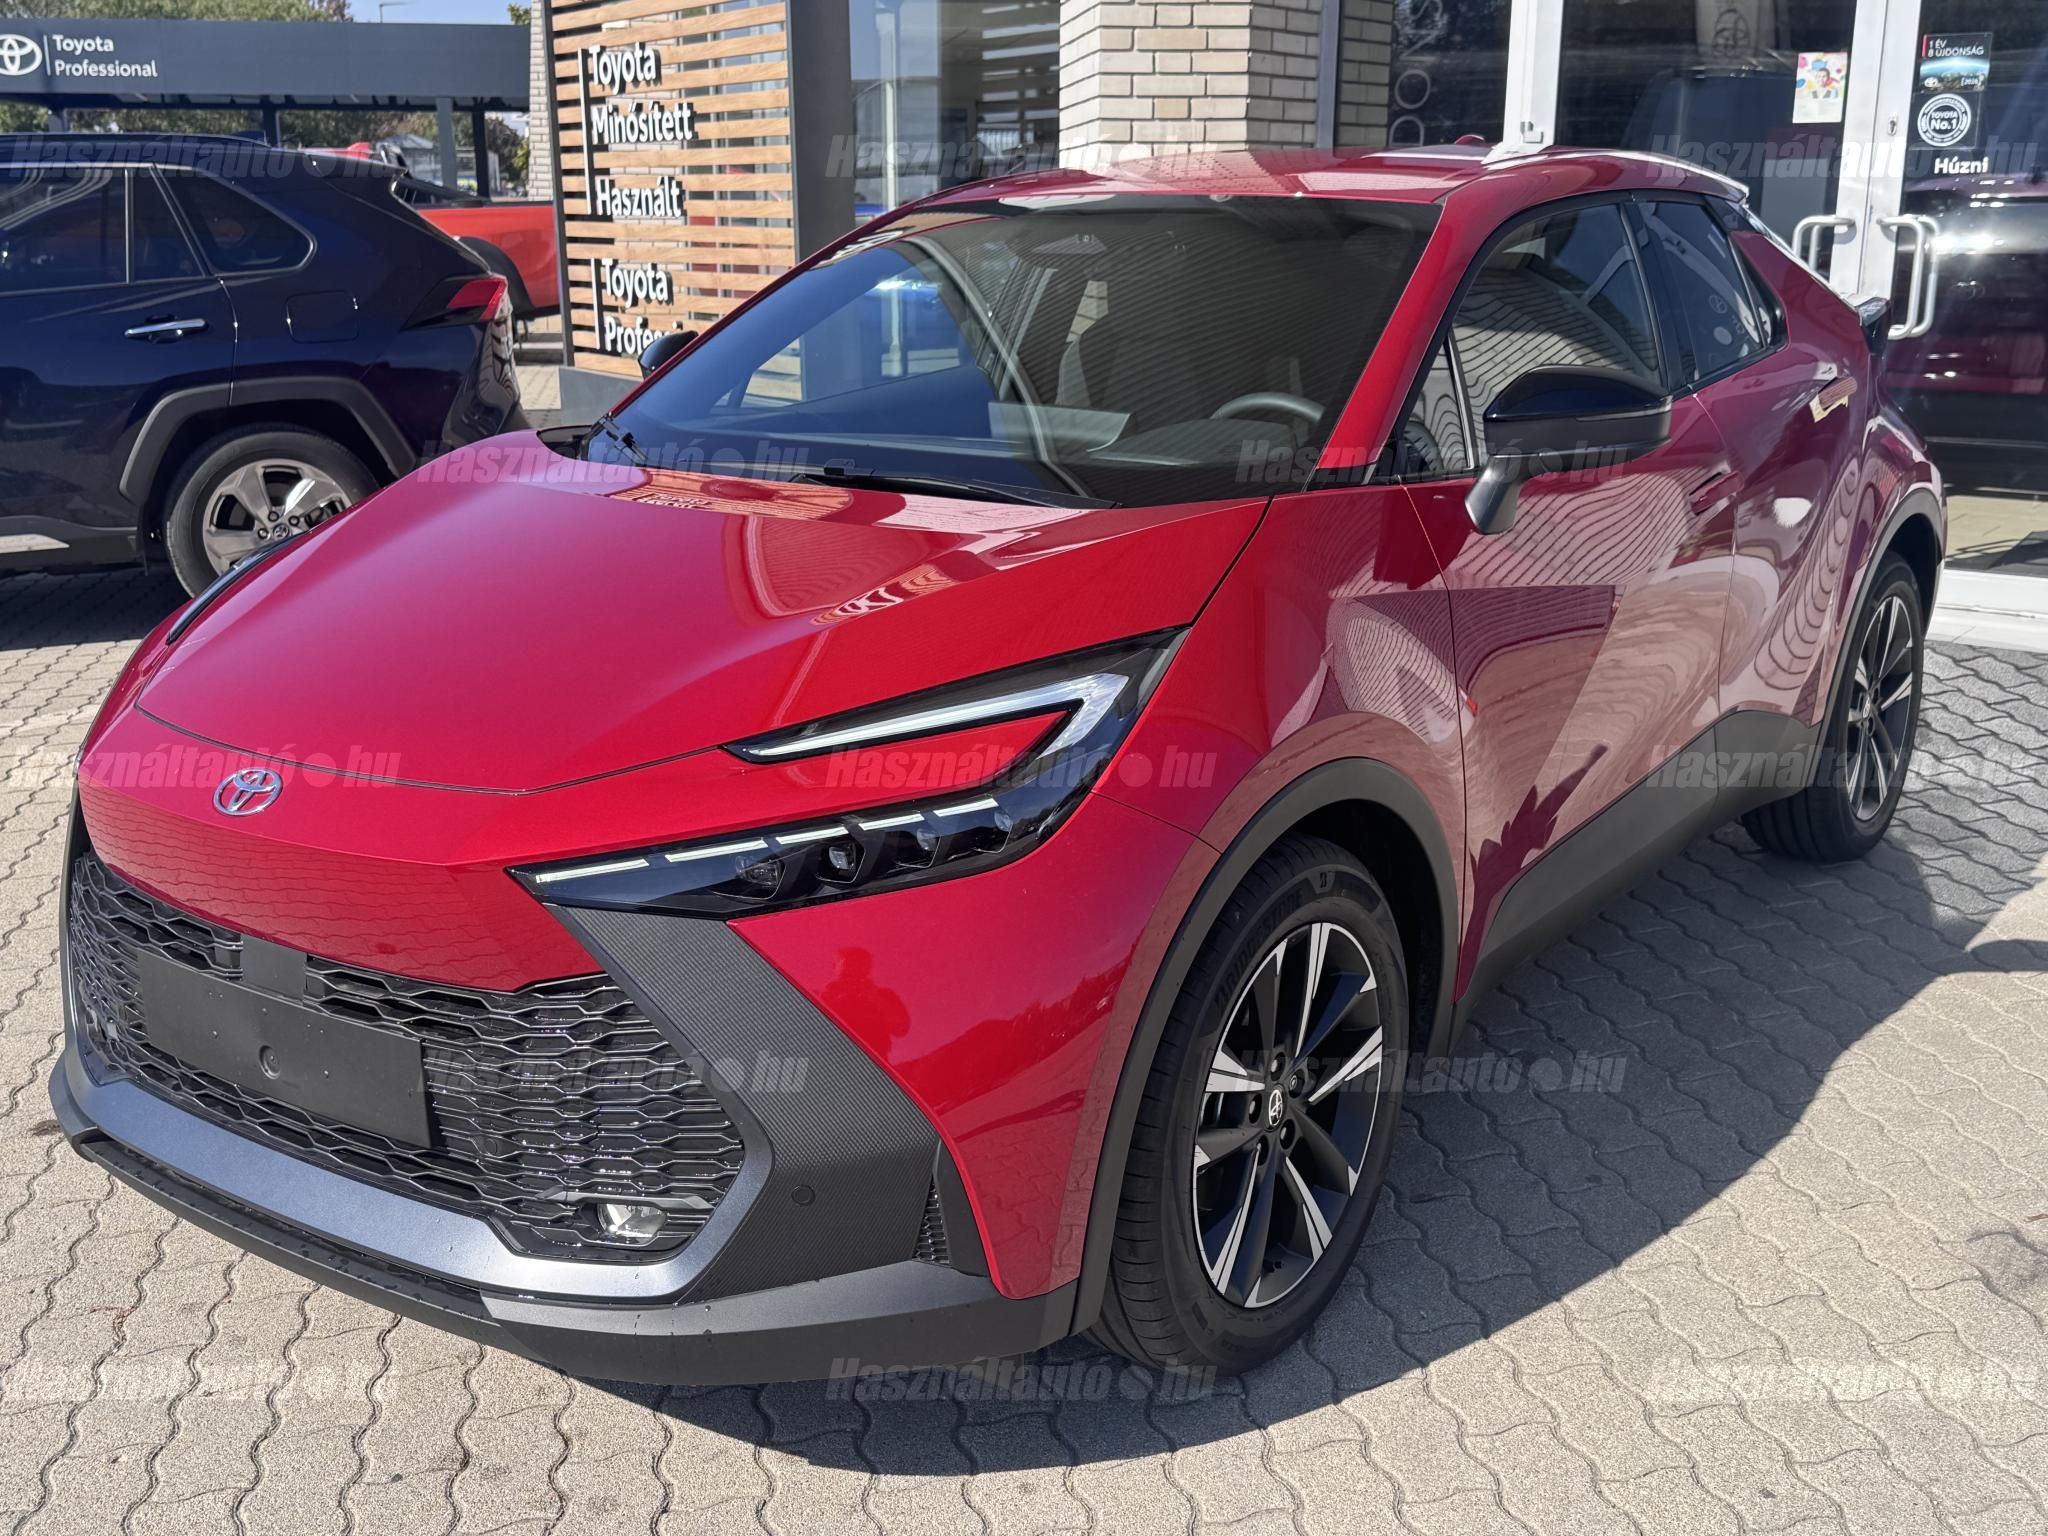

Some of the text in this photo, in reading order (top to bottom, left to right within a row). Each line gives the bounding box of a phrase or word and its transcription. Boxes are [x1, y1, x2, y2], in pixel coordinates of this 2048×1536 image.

[52, 34, 114, 53] Toyota
[54, 60, 158, 78] Professional
[589, 42, 657, 95] Toyota
[591, 101, 693, 144] Minősített
[1930, 119, 1957, 130] No.1
[1931, 111, 1958, 119] TOYOTA
[1934, 156, 1989, 174] Húzni
[595, 176, 682, 217] Használt
[601, 257, 669, 309] Toyota
[605, 316, 677, 355] Profe
